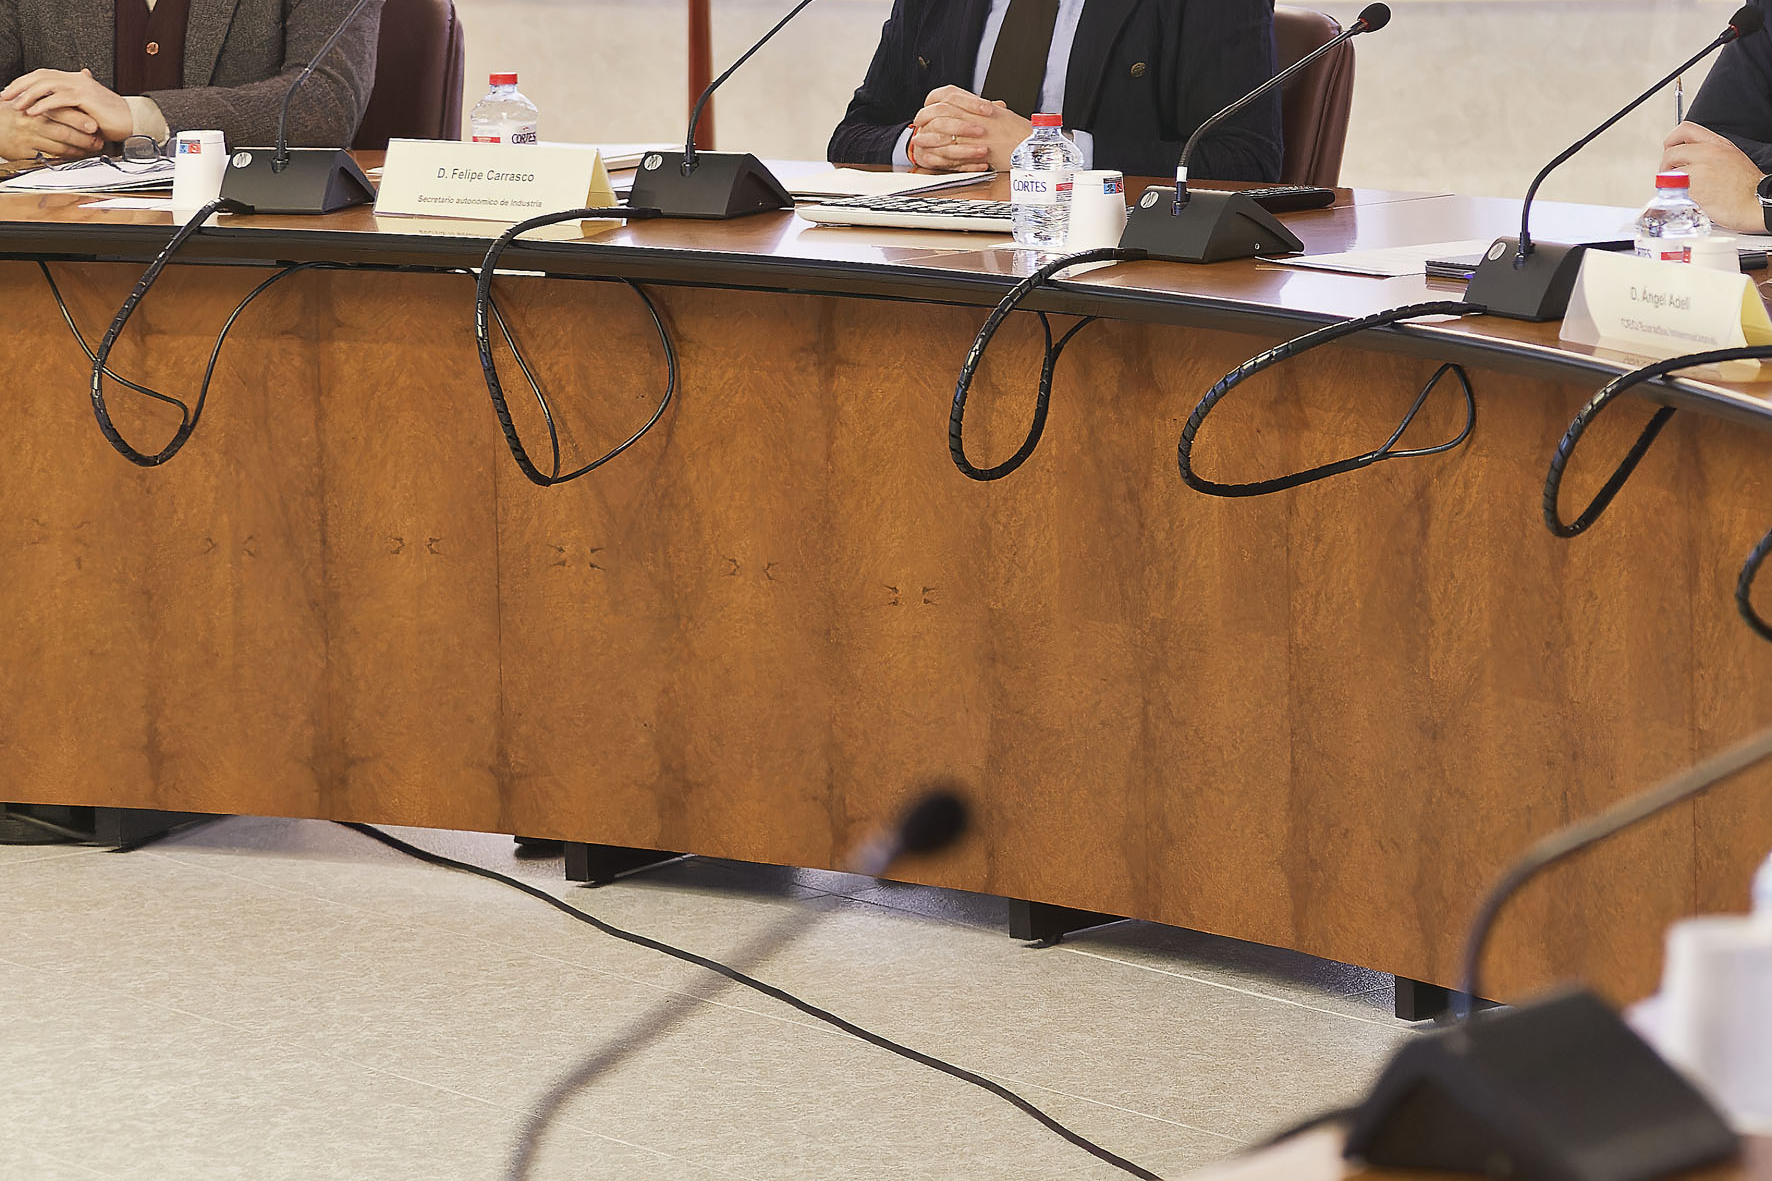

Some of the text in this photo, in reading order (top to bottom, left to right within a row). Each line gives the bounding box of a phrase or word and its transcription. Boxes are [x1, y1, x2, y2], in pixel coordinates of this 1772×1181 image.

[511, 132, 536, 145] CORTES
[437, 167, 535, 183] D. Felipe Carrasco
[1013, 179, 1047, 193] CORTES
